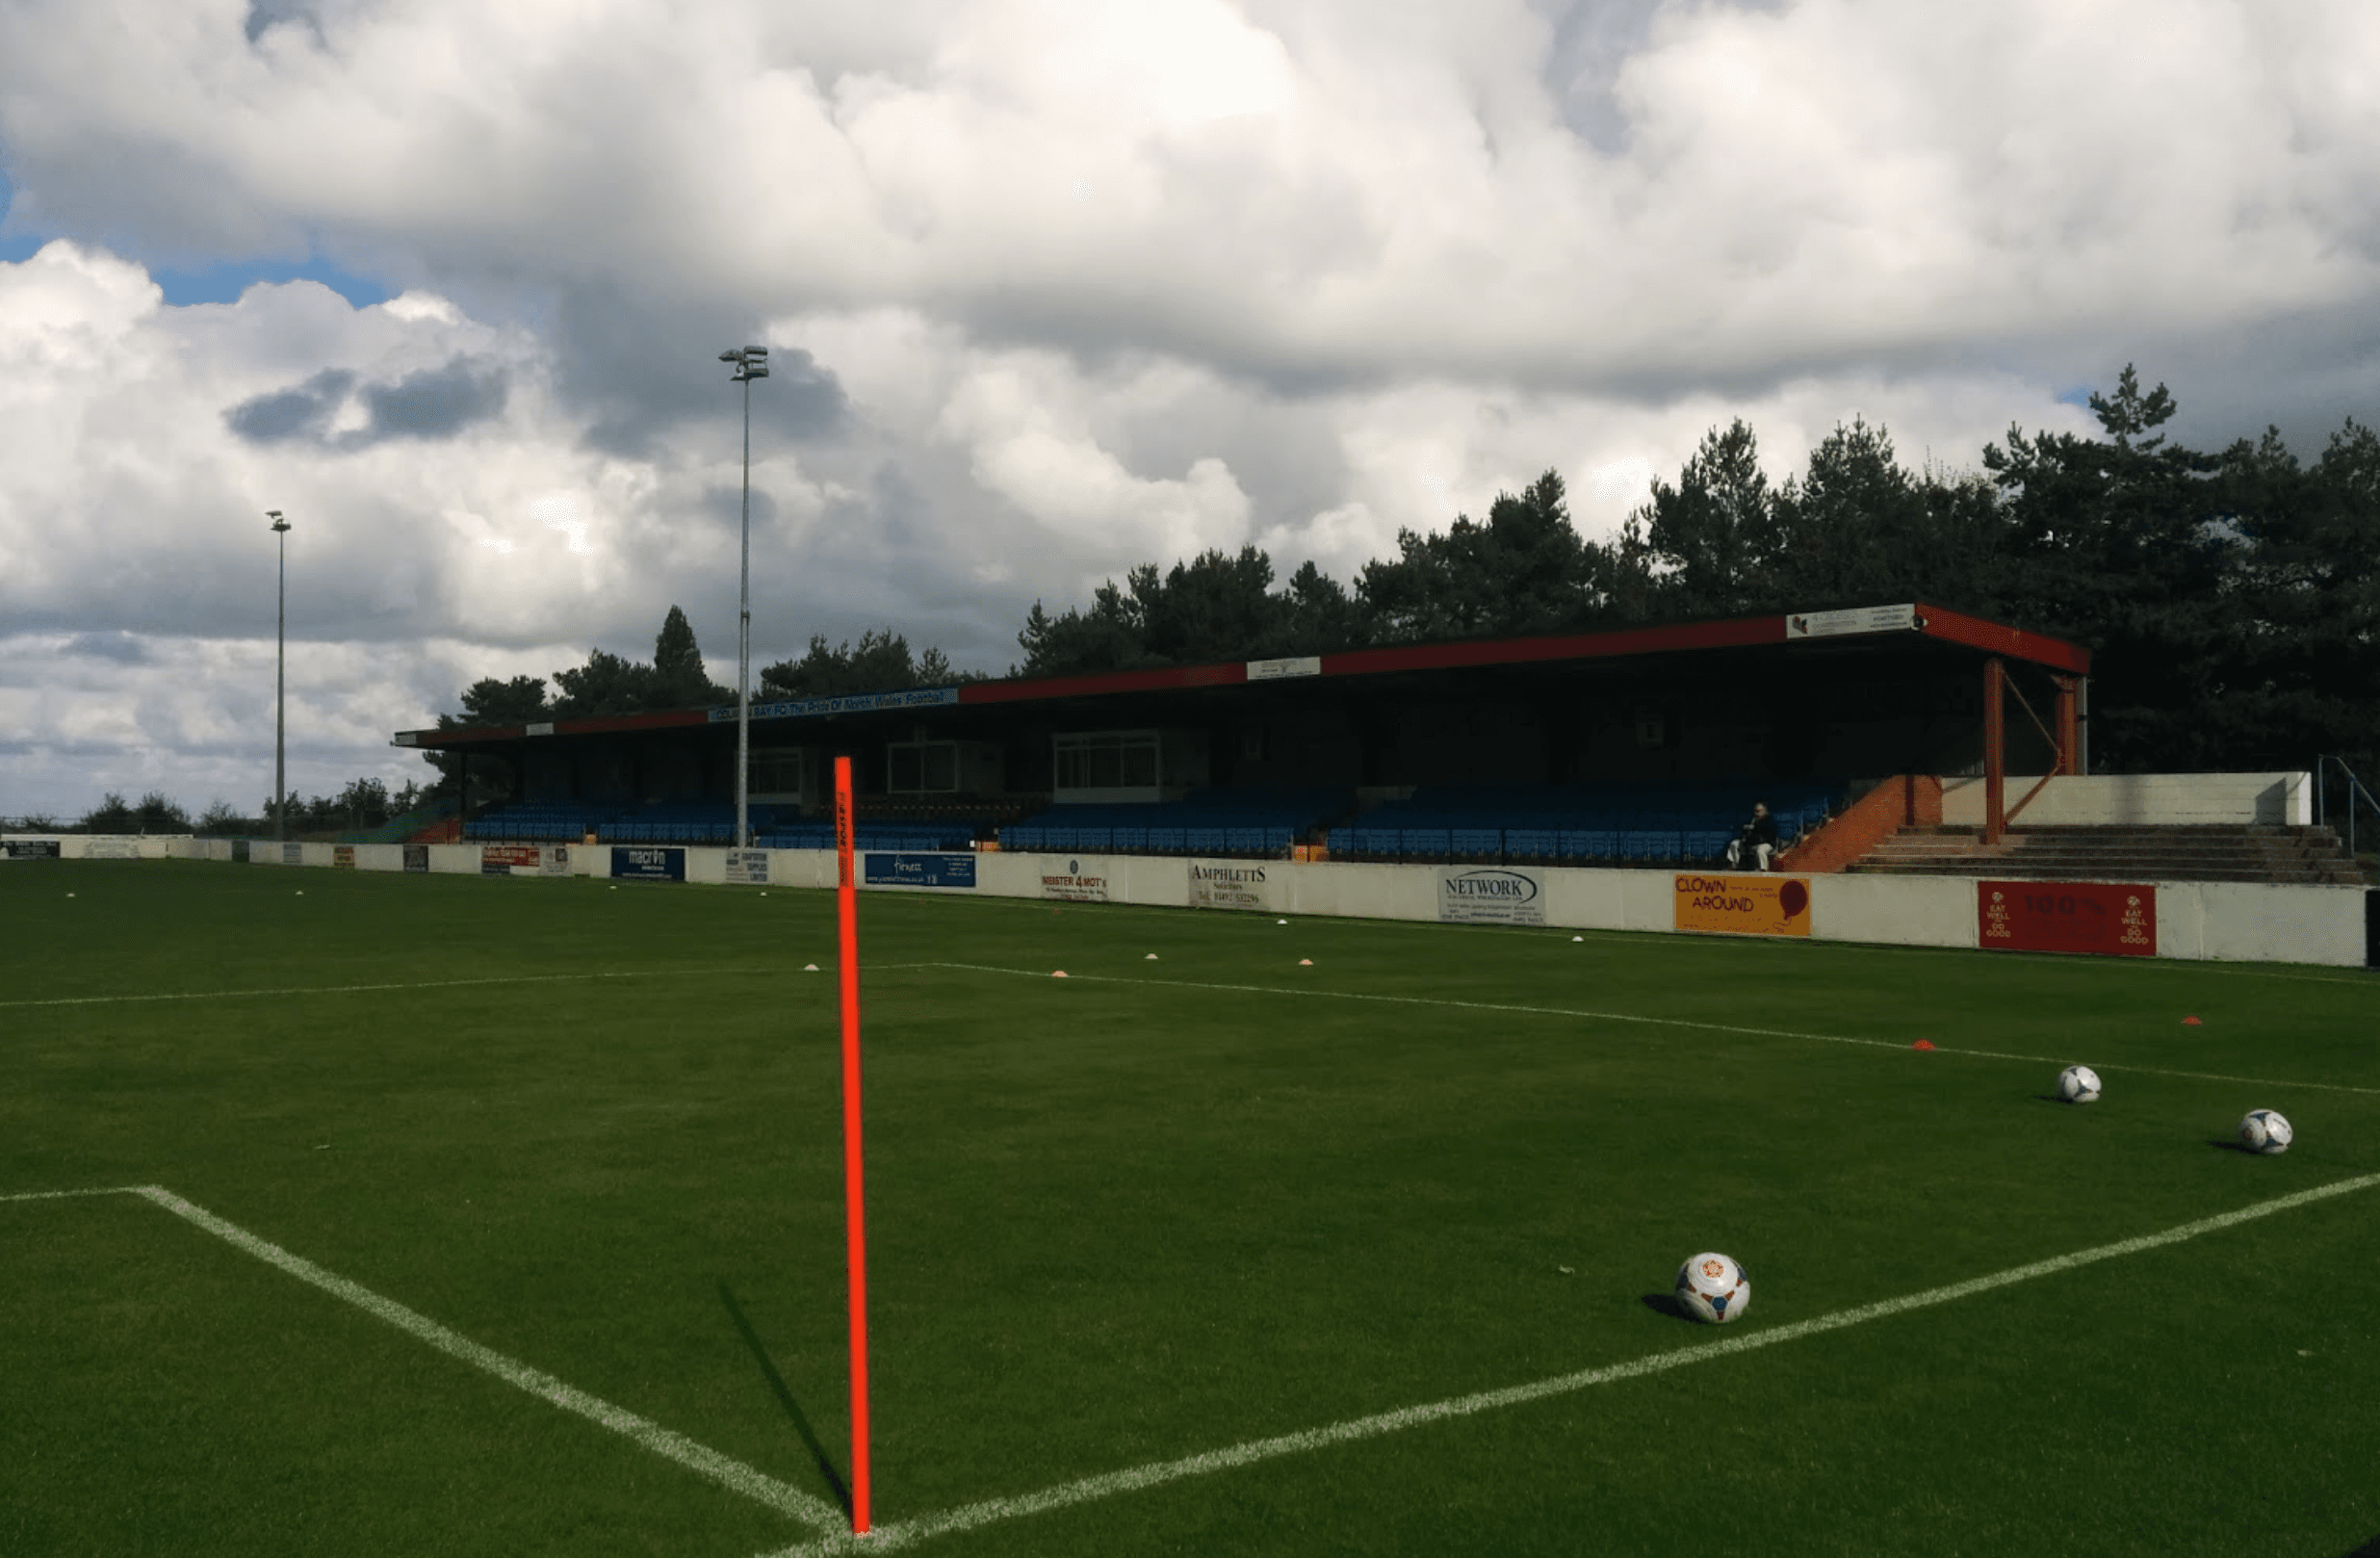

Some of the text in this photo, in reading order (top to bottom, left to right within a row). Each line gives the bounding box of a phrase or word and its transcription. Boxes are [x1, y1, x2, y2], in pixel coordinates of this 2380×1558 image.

[629, 849, 666, 865] macron
[1446, 878, 1523, 896] NETWORK
[1675, 877, 1727, 894] CLOWN
[1692, 896, 1754, 913] AROUND
[1989, 904, 2005, 913] EAT
[1986, 911, 2010, 921] WELL
[2124, 908, 2142, 918] EAT
[2120, 917, 2147, 926] WELL
[1985, 929, 2011, 938] GOOD
[2127, 927, 2141, 936] DO
[2120, 936, 2149, 945] GOOD
